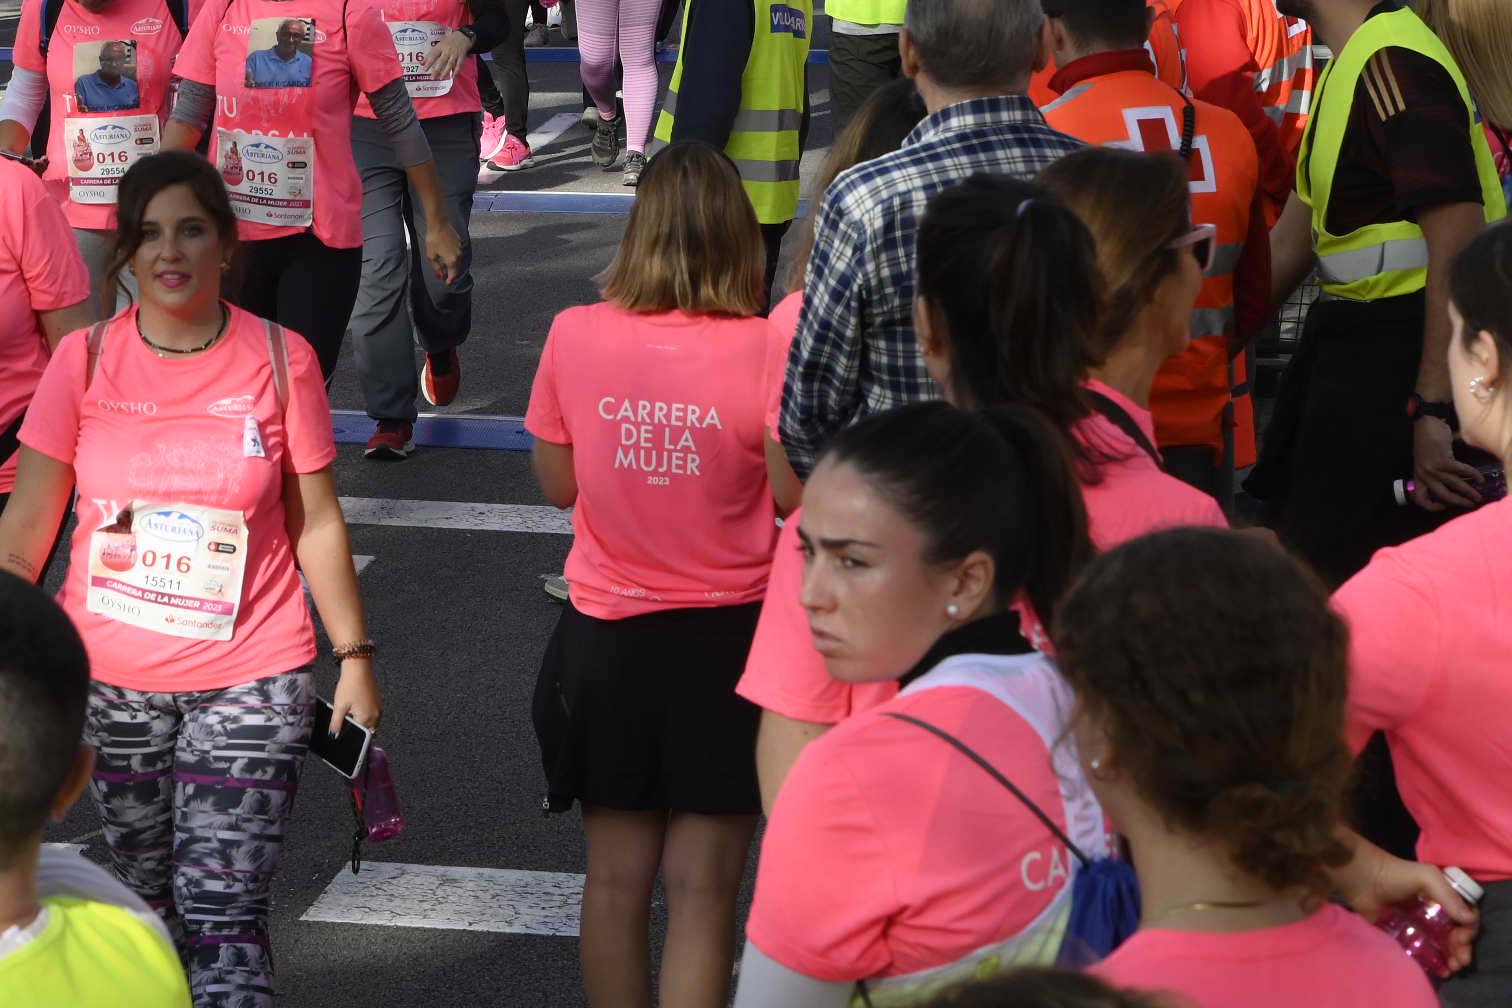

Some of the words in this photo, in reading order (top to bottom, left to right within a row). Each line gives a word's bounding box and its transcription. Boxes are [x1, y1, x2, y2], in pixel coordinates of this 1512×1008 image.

[217, 95, 237, 117] TU
[92, 130, 129, 142] ASTURIANA
[96, 150, 129, 165] 016
[243, 147, 282, 161] ASTURIANA
[245, 169, 279, 185] 016
[248, 185, 274, 196] 29552
[97, 399, 157, 416] OYSHO
[598, 396, 723, 429] CARRERA
[621, 423, 654, 447] DE
[664, 427, 697, 451] LA
[614, 446, 701, 476] MUJER
[647, 476, 670, 485] 2023
[143, 518, 202, 539] ASTURIANA
[209, 524, 239, 536] SUMA
[141, 549, 192, 574] 016
[144, 574, 183, 592] 15511
[106, 579, 143, 599] CARRERA
[143, 592, 157, 602] DE
[157, 594, 169, 604] LA
[169, 596, 201, 609] MUJER
[101, 594, 142, 617] OYSHO
[176, 616, 224, 631] Santander
